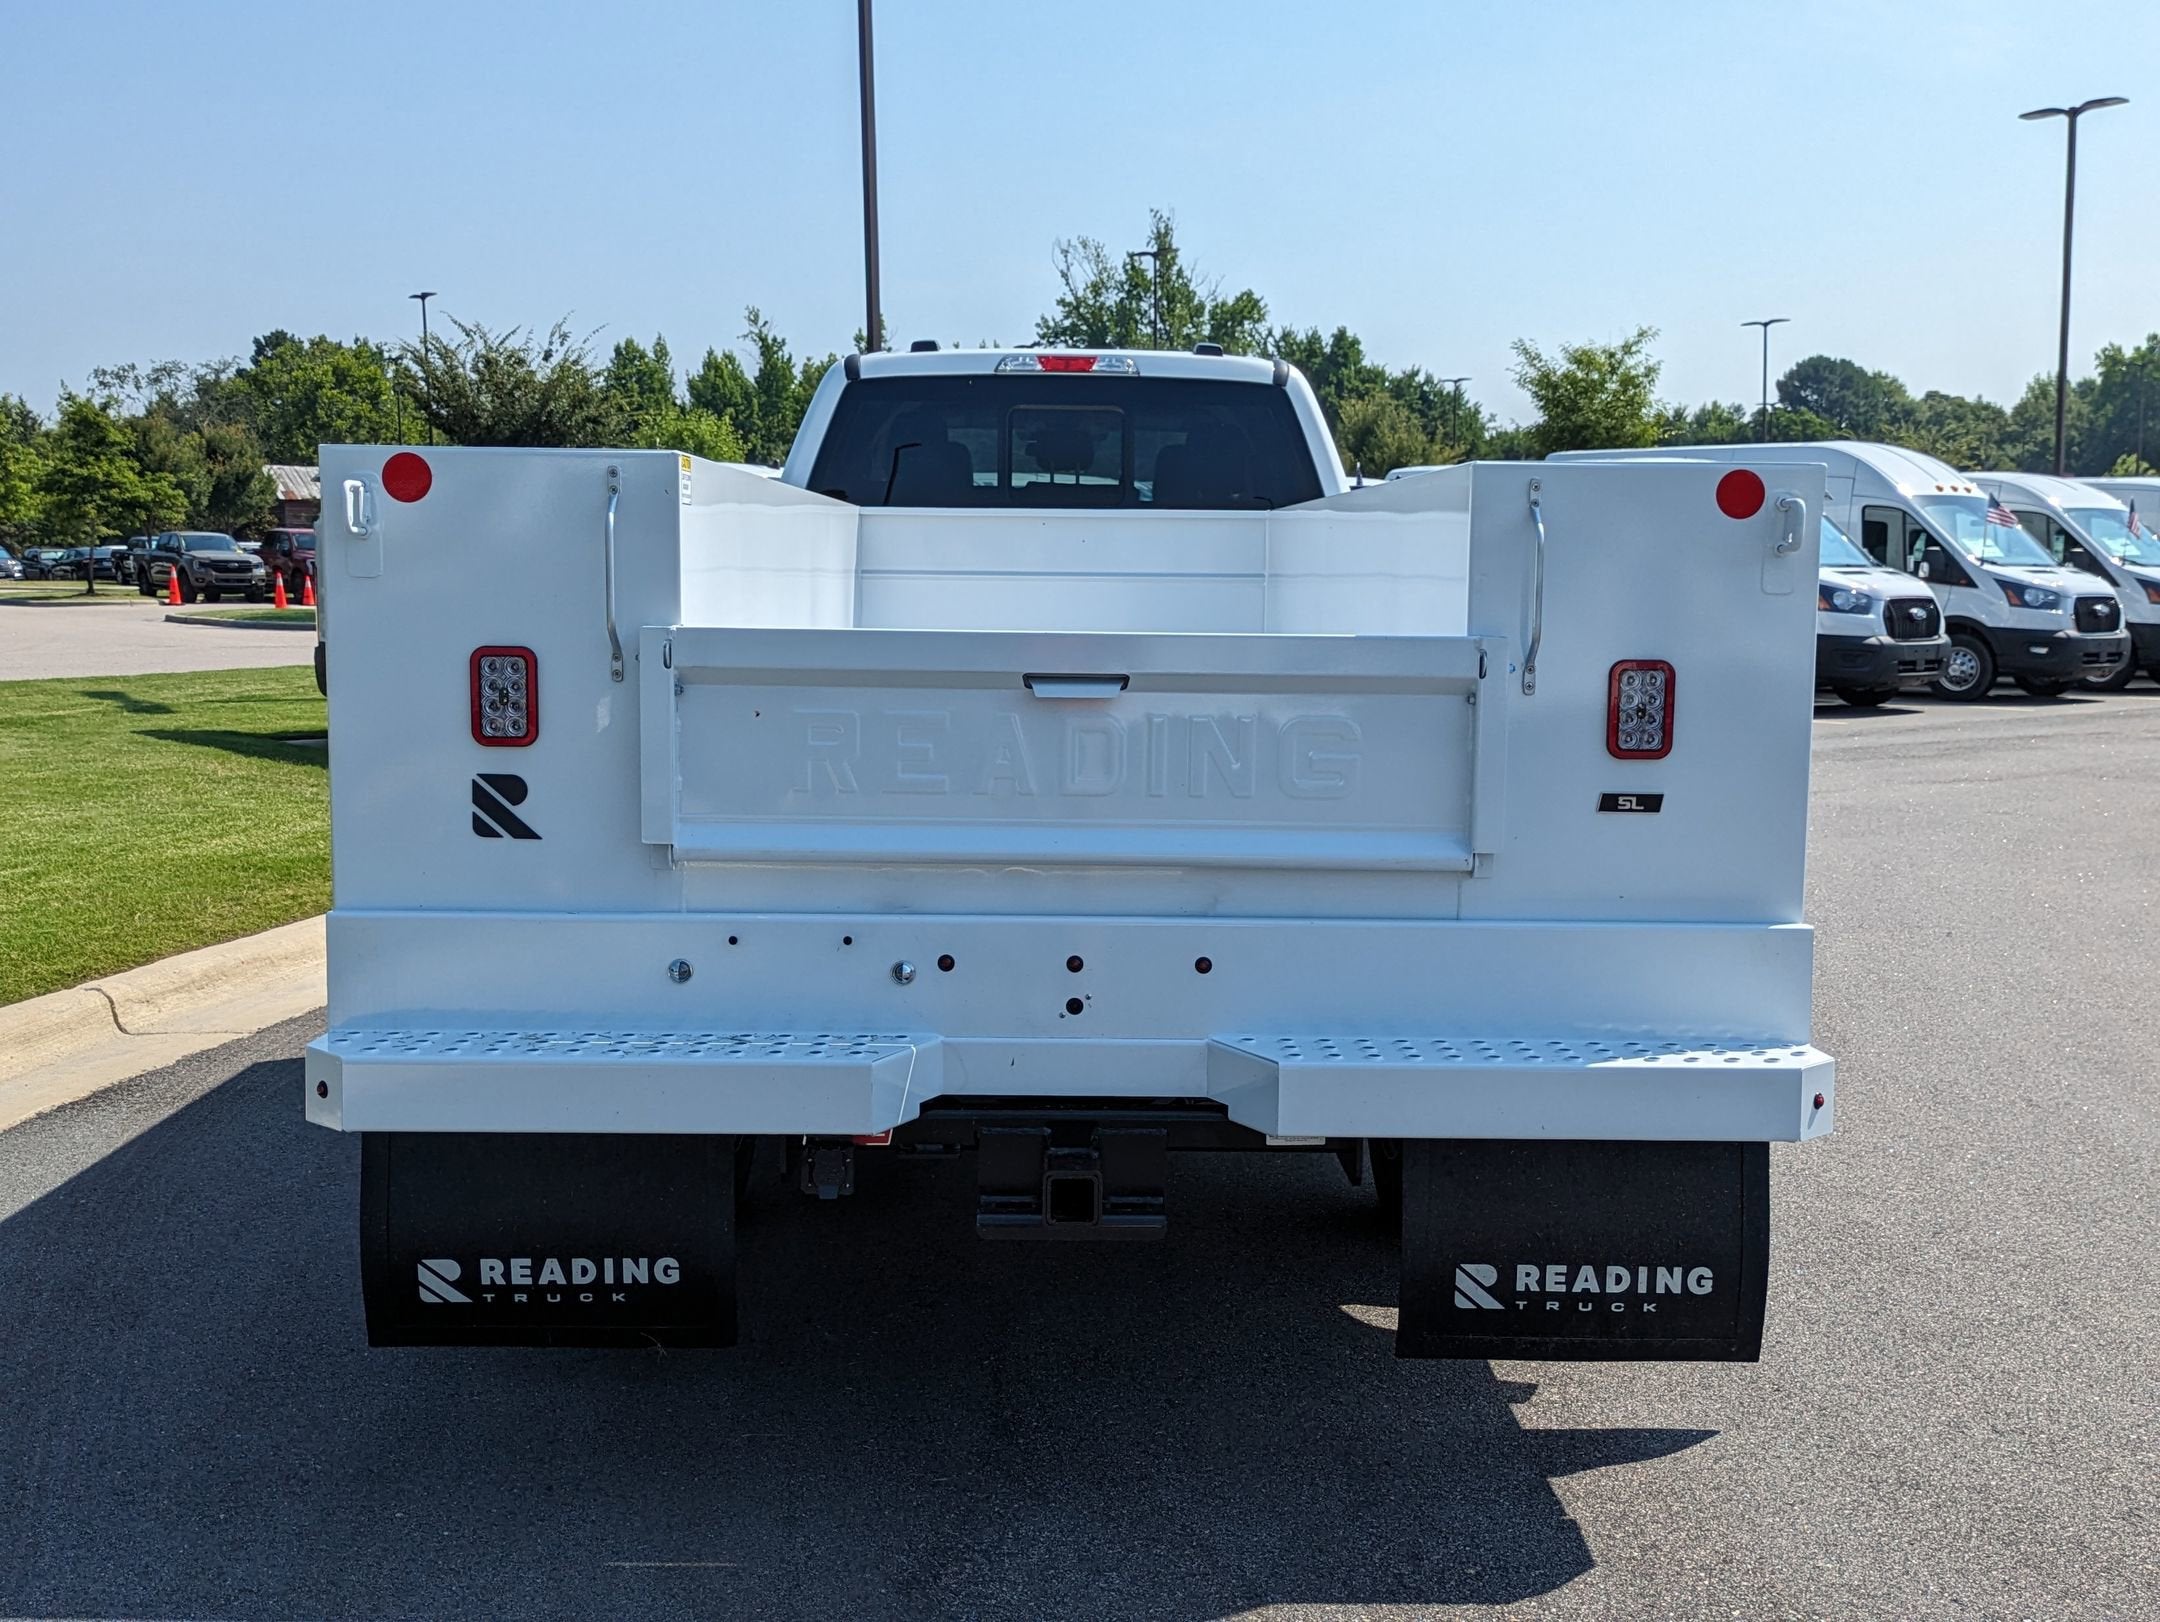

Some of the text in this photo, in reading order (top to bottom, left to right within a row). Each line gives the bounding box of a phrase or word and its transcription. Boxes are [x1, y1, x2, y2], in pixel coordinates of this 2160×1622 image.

[792, 707, 1363, 800] READING
[1617, 796, 1645, 810] SL
[480, 1257, 681, 1286] READING
[1516, 1264, 1714, 1295] READING
[482, 1292, 627, 1303] TRUCK
[1515, 1301, 1658, 1313] TRUCK
